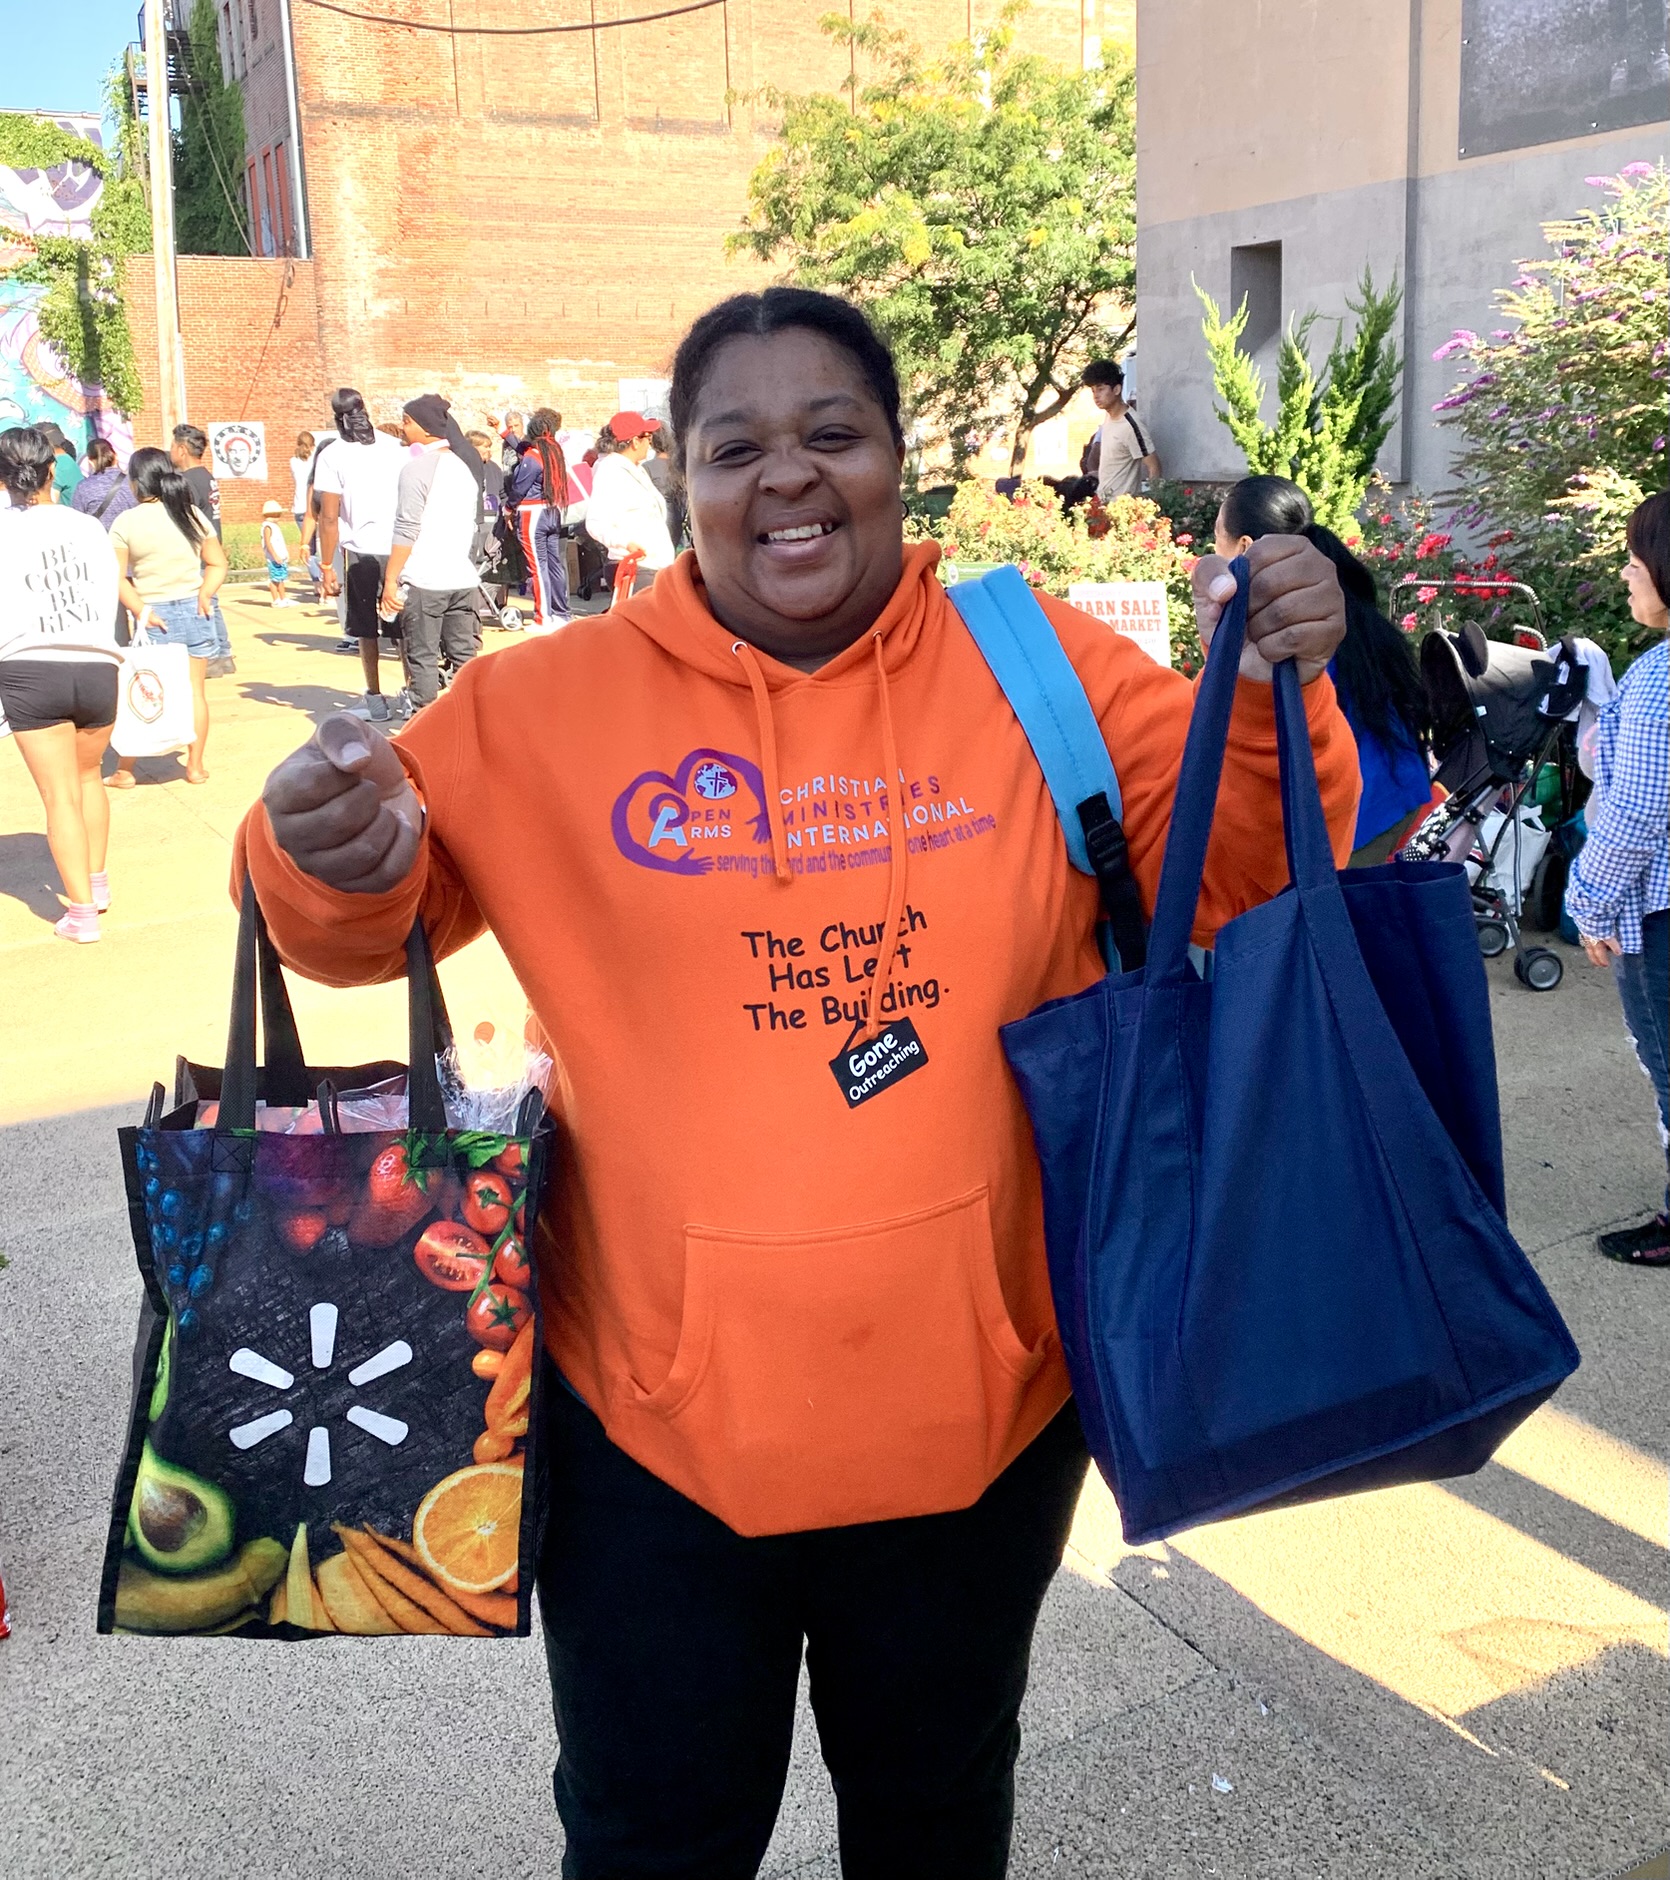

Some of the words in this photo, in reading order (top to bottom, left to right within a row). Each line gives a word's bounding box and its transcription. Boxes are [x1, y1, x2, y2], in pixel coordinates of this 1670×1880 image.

[25, 561, 95, 592] COOL
[41, 542, 76, 570] BE
[50, 583, 85, 612] BE
[1074, 600, 1116, 616] BARN
[1121, 600, 1160, 615] SALE
[1109, 619, 1162, 632] MARKET
[648, 806, 732, 848] ARMS
[787, 797, 974, 849] NTERNAIONAL
[717, 854, 758, 879] serving
[806, 849, 827, 874] and
[828, 848, 847, 871] the
[847, 844, 892, 869] commun
[907, 835, 928, 854] one
[926, 829, 955, 852] heart
[954, 824, 968, 842] at
[964, 823, 974, 839] a
[971, 813, 996, 836] time
[741, 930, 806, 959] The
[769, 962, 831, 992] Has
[843, 943, 912, 984] Let
[743, 1001, 808, 1031] The
[821, 978, 950, 1026] Buiding.
[848, 1033, 899, 1078] Gone
[849, 1040, 921, 1101] Outreaching
